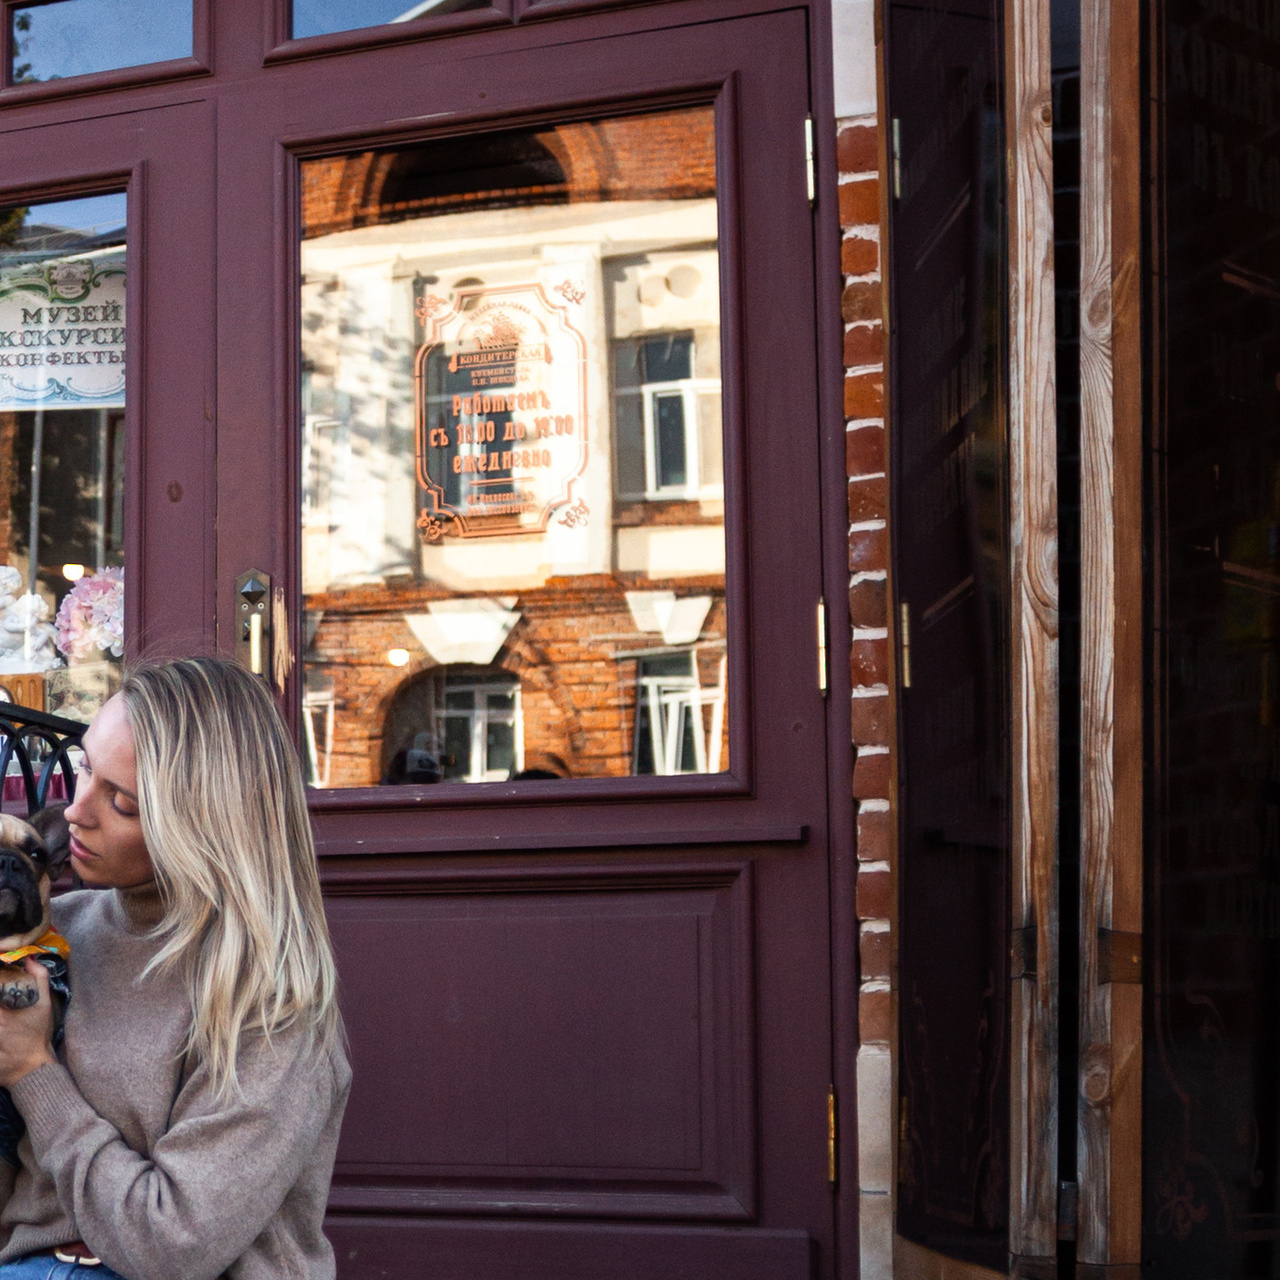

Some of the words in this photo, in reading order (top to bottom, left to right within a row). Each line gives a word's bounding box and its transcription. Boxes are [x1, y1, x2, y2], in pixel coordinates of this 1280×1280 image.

[20, 299, 121, 325] МУЗЕЙ
[459, 346, 542, 365] КОНДИТЕРСКАЯ
[452, 389, 551, 417] Работаемъ
[452, 449, 552, 474] ежедневно
